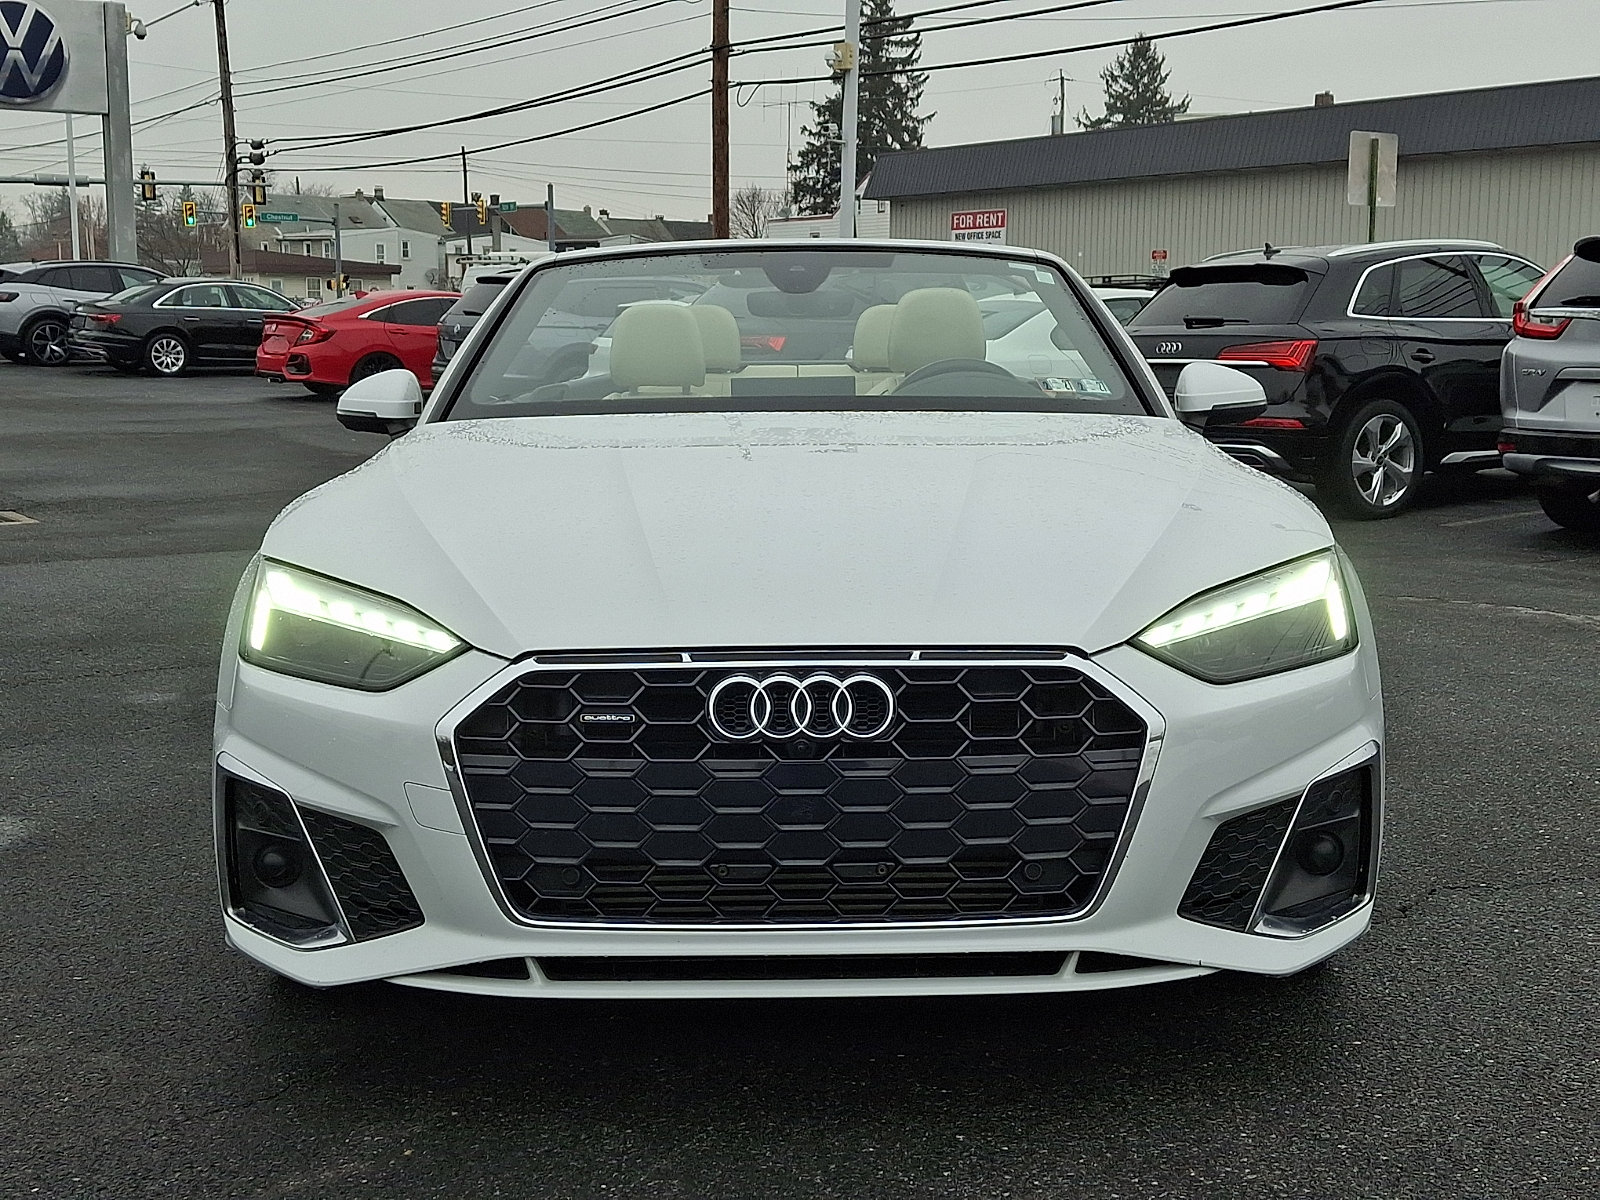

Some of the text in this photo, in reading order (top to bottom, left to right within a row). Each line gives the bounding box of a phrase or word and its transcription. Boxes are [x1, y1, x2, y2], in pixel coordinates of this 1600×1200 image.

[266, 213, 293, 221] Chestnut
[953, 212, 1004, 229] FOR RENT
[954, 230, 1002, 241] NEW OFFICE SPACE
